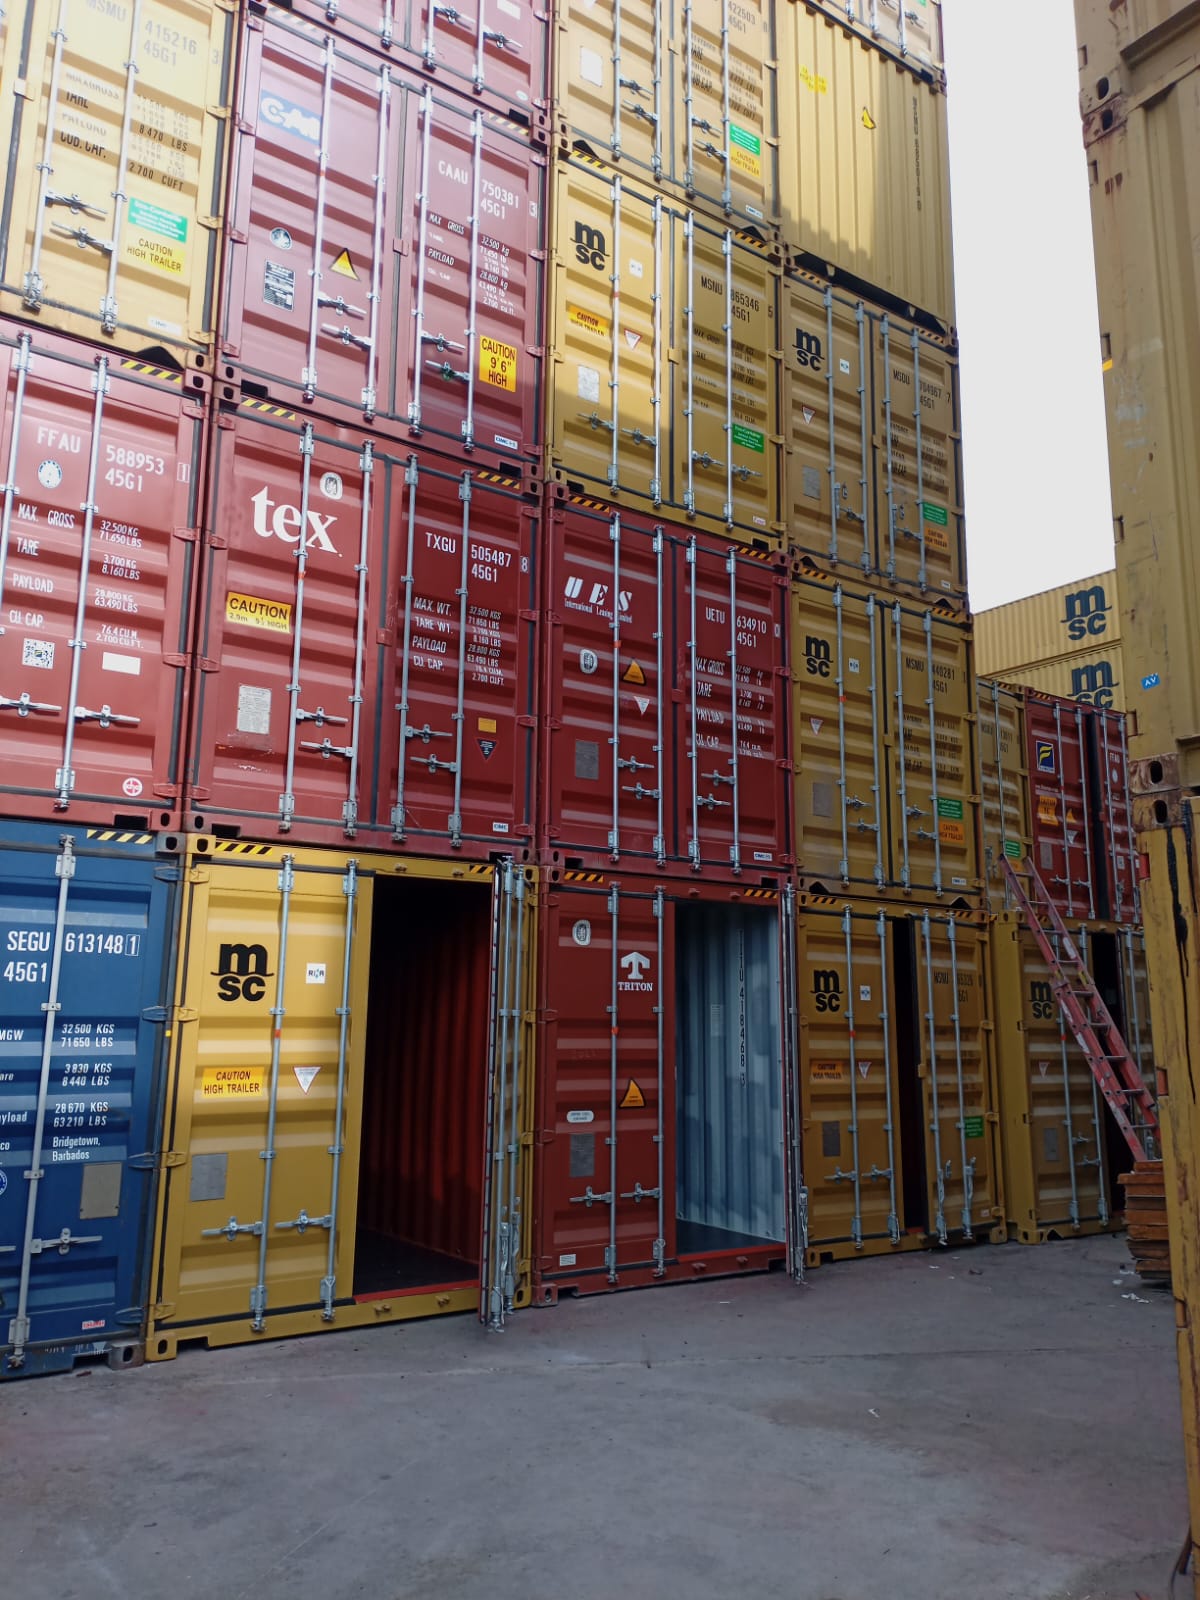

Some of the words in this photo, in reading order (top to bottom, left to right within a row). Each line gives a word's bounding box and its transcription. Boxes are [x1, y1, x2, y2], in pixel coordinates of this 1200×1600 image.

[437, 160, 469, 185] CAAU
[480, 178, 520, 209] 750381
[479, 199, 506, 220] 45G1
[428, 213, 442, 226] MAX
[447, 220, 465, 236] GROSS
[138, 237, 174, 257] CAUTION
[126, 245, 147, 260] HIGH
[149, 252, 183, 272] TRAILER
[427, 248, 456, 267] PAYLOAD
[700, 274, 723, 295] MSNU
[480, 337, 516, 361] CAUTION
[487, 369, 508, 388] HIGH
[36, 426, 82, 454] FFAU
[105, 444, 166, 476] 588953
[104, 467, 144, 493] 45G1
[18, 502, 39, 522] MAX.
[47, 509, 75, 529] GROSS
[127, 527, 139, 538] KG
[16, 536, 40, 557] TARE
[126, 537, 142, 549] LBS
[425, 531, 457, 554] TXGU
[470, 543, 513, 569] 505487
[520, 556, 529, 574] 8
[126, 559, 137, 570] KG
[470, 562, 498, 584] 45G1
[12, 572, 54, 594] PAYLOAD
[124, 570, 140, 581] LBS
[122, 601, 138, 614] LBS
[228, 597, 288, 620] CAUTION
[413, 596, 435, 614] MAX.
[413, 616, 435, 632] TARE
[705, 606, 726, 625] UETU
[736, 614, 768, 635] 634910
[411, 635, 447, 655] PAYLOAD
[736, 631, 757, 648] 45G1
[696, 681, 713, 698] TARE
[695, 707, 725, 725] PAYLOAD
[6, 930, 51, 952] SEGU
[64, 932, 124, 955] 613148
[3, 961, 48, 983] 45G1
[617, 981, 653, 992] TRITON
[96, 1023, 115, 1034] KGS
[95, 1037, 113, 1048] LBS
[94, 1063, 113, 1073] KGS
[216, 1070, 251, 1081] CAUTION
[91, 1075, 110, 1086] LBS
[204, 1082, 224, 1095] HIGH
[226, 1081, 261, 1093] TRAILER
[90, 1101, 109, 1112] KGS
[88, 1115, 107, 1126] LBS
[52, 1135, 101, 1149] Bridgetown,
[52, 1149, 90, 1162] Barbados
